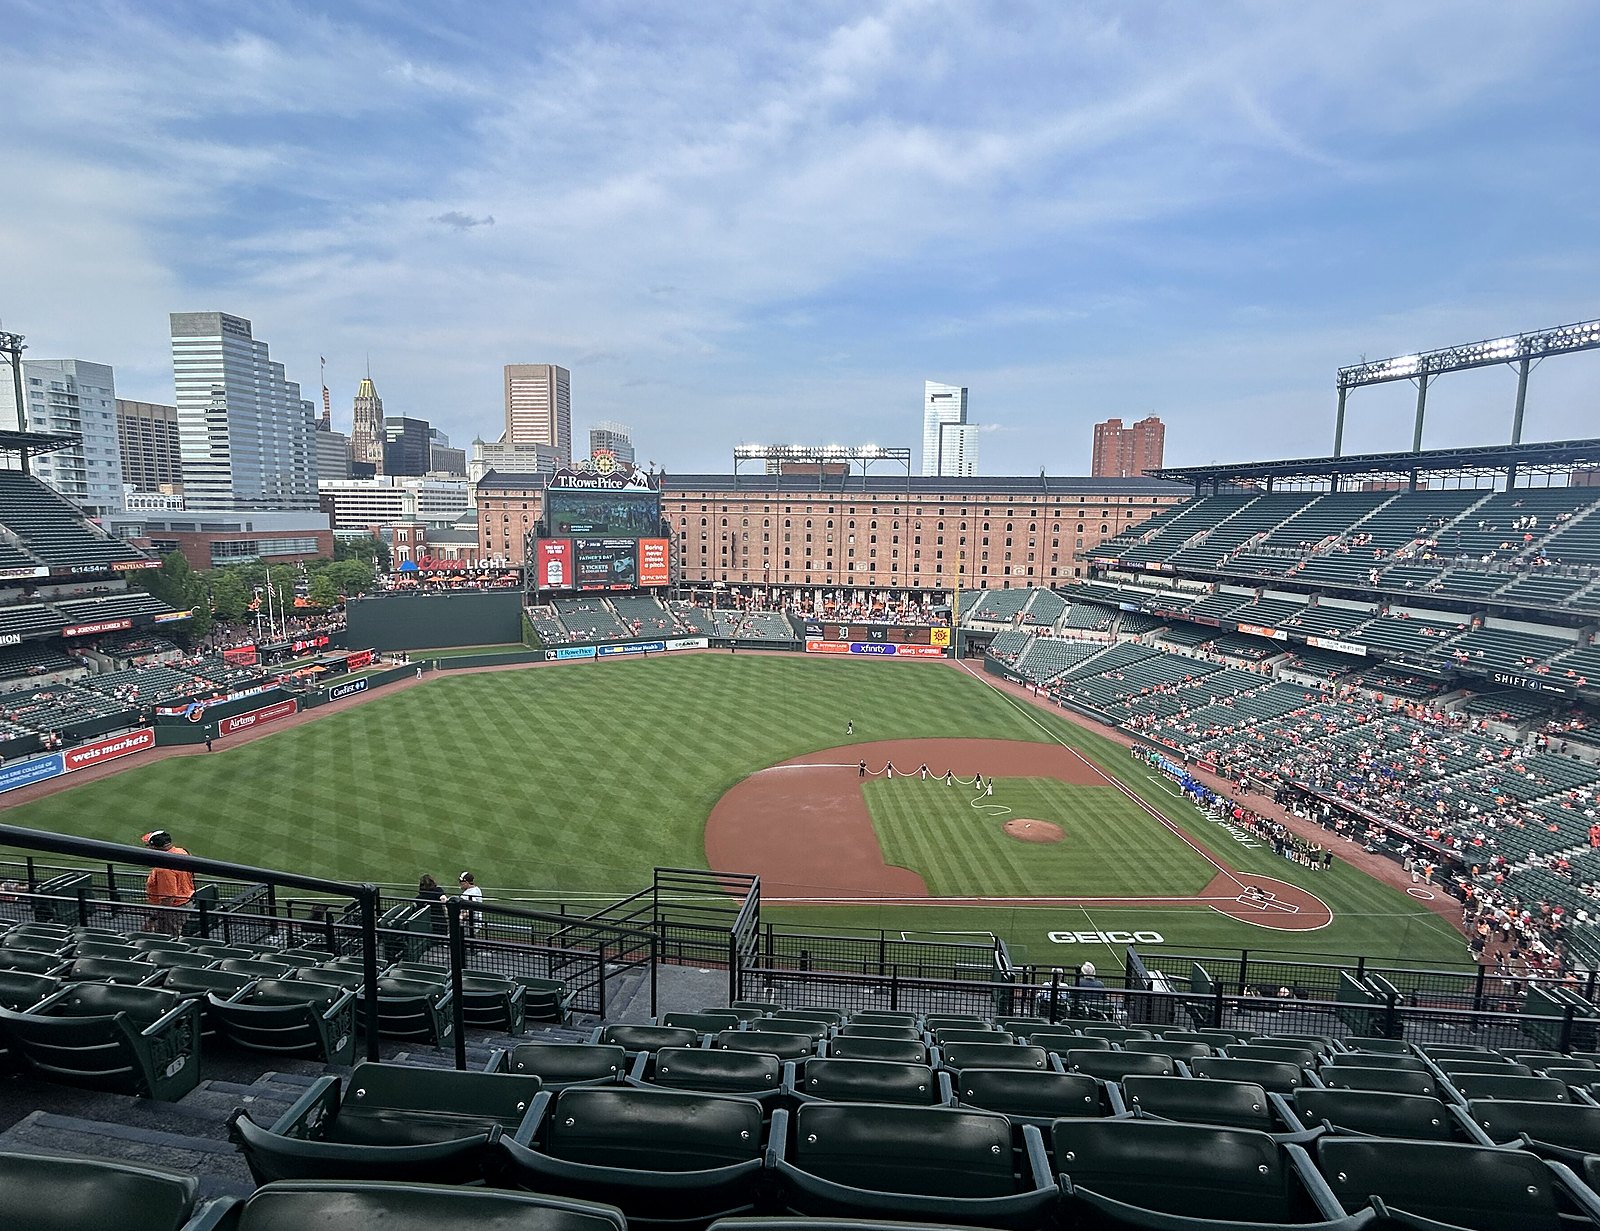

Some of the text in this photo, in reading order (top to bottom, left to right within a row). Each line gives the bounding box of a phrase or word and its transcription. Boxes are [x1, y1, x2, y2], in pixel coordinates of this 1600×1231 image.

[113, 562, 145, 570] POMPEIAN
[466, 559, 507, 570] LIGHT
[77, 624, 100, 633] JOHNSON
[101, 622, 120, 630] LUMBER
[871, 631, 882, 639] VS
[860, 645, 886, 653] xfinity
[1494, 673, 1527, 687] SHIFT
[226, 686, 262, 701] BIRD BATH
[230, 715, 256, 728] Airtemp
[71, 734, 149, 763] weis markets
[22, 763, 45, 774] COLLEGE
[32, 765, 57, 777] MEDICINE
[1047, 931, 1165, 944] GEICO
